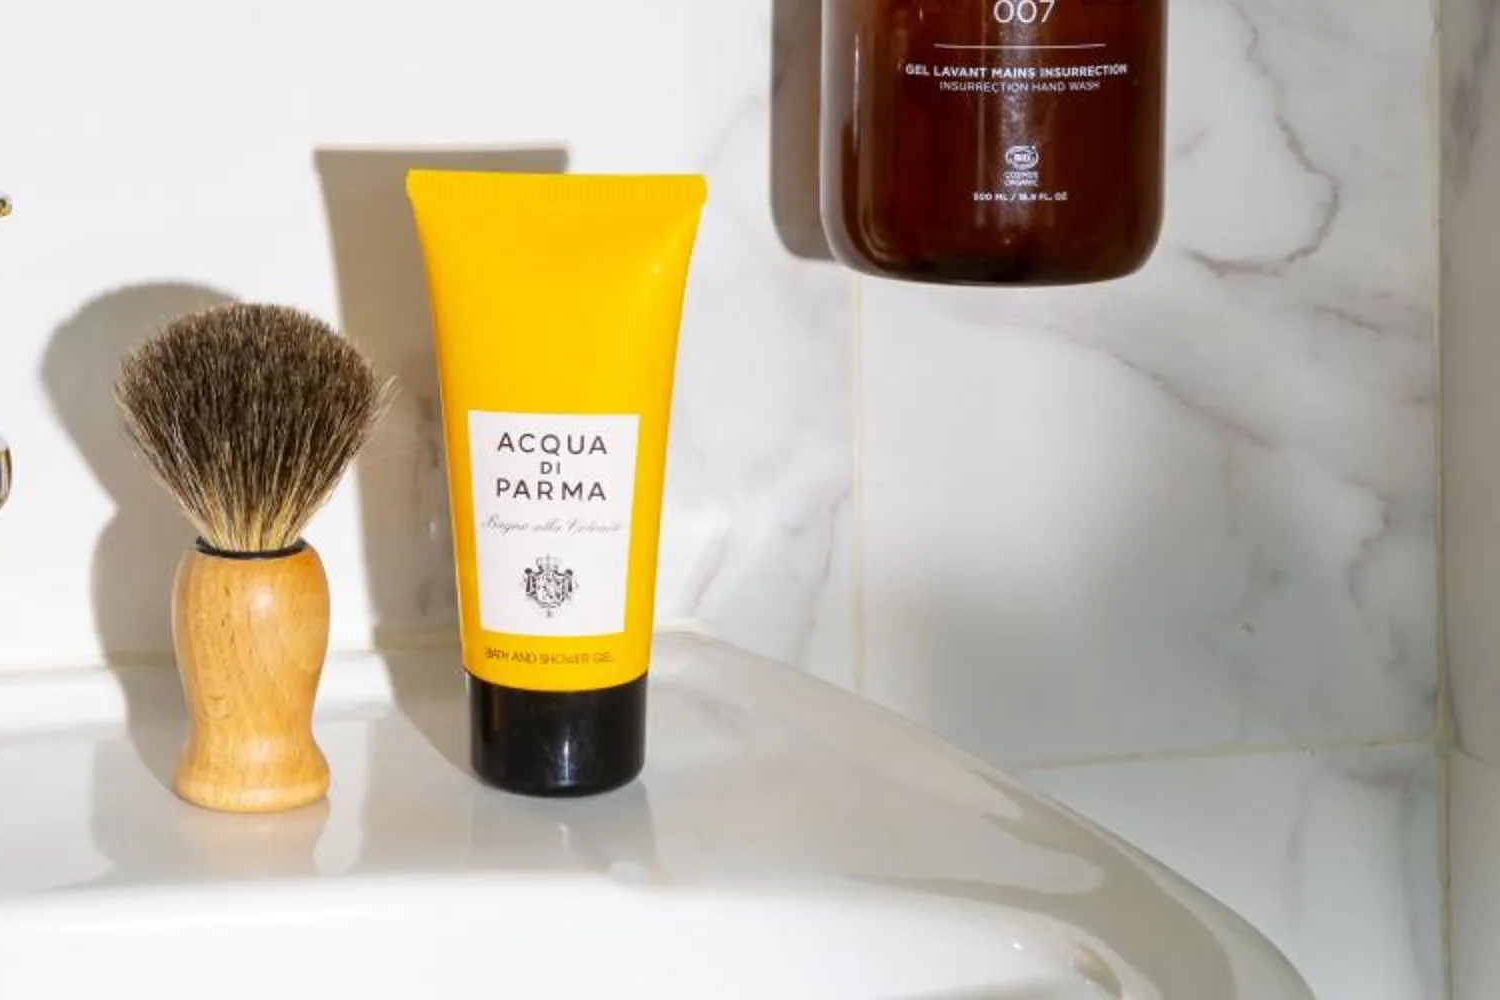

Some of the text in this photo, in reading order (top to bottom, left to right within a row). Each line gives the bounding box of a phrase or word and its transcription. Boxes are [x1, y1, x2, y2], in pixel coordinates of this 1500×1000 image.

[905, 63, 1128, 79] GEL LAVANT MAINS INSURRECTION
[939, 80, 1101, 93] INSURRECTION HAND WASH
[497, 432, 607, 456] ACQUA
[540, 461, 561, 474] DI
[496, 477, 606, 501] PARMA
[511, 651, 538, 664] AND
